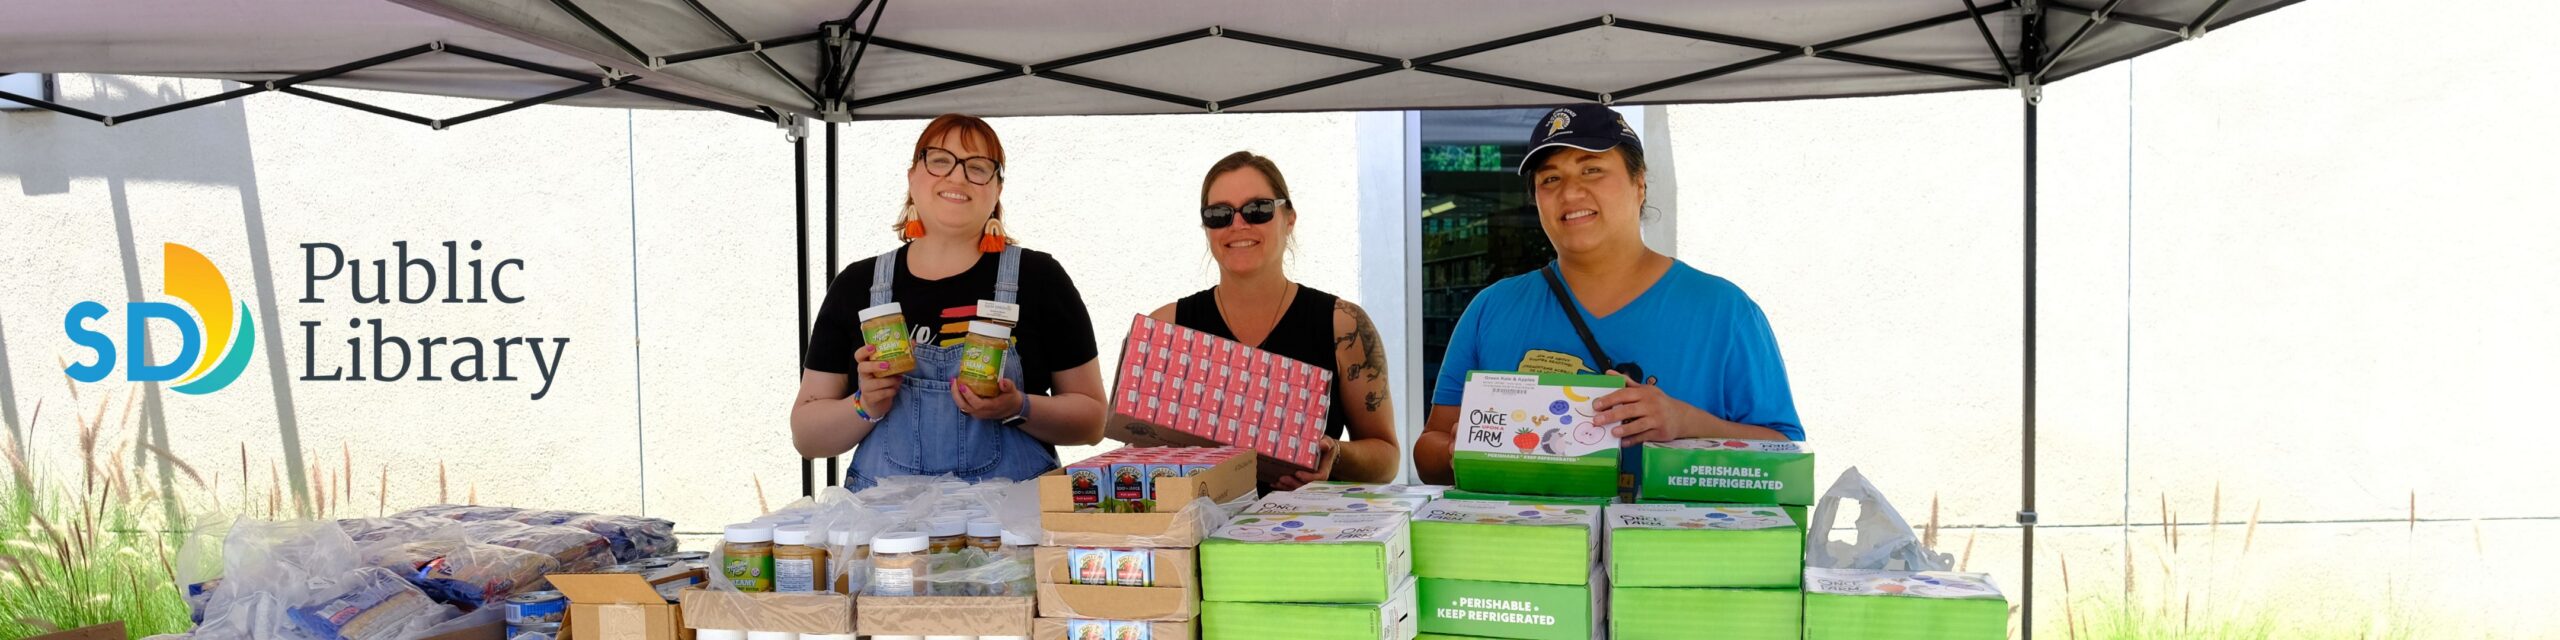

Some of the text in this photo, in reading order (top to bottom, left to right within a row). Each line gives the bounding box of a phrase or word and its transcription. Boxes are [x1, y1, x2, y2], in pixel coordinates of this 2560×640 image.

[1470, 409, 1507, 425] ONCE
[1468, 425, 1503, 447] FARM
[1690, 465, 1761, 478] PERISHABLE
[1668, 476, 1784, 490] KEEP REFRIGERATED
[1459, 597, 1532, 611] PERISHABLE
[1437, 608, 1556, 626] KEEP REFRIGERATED
